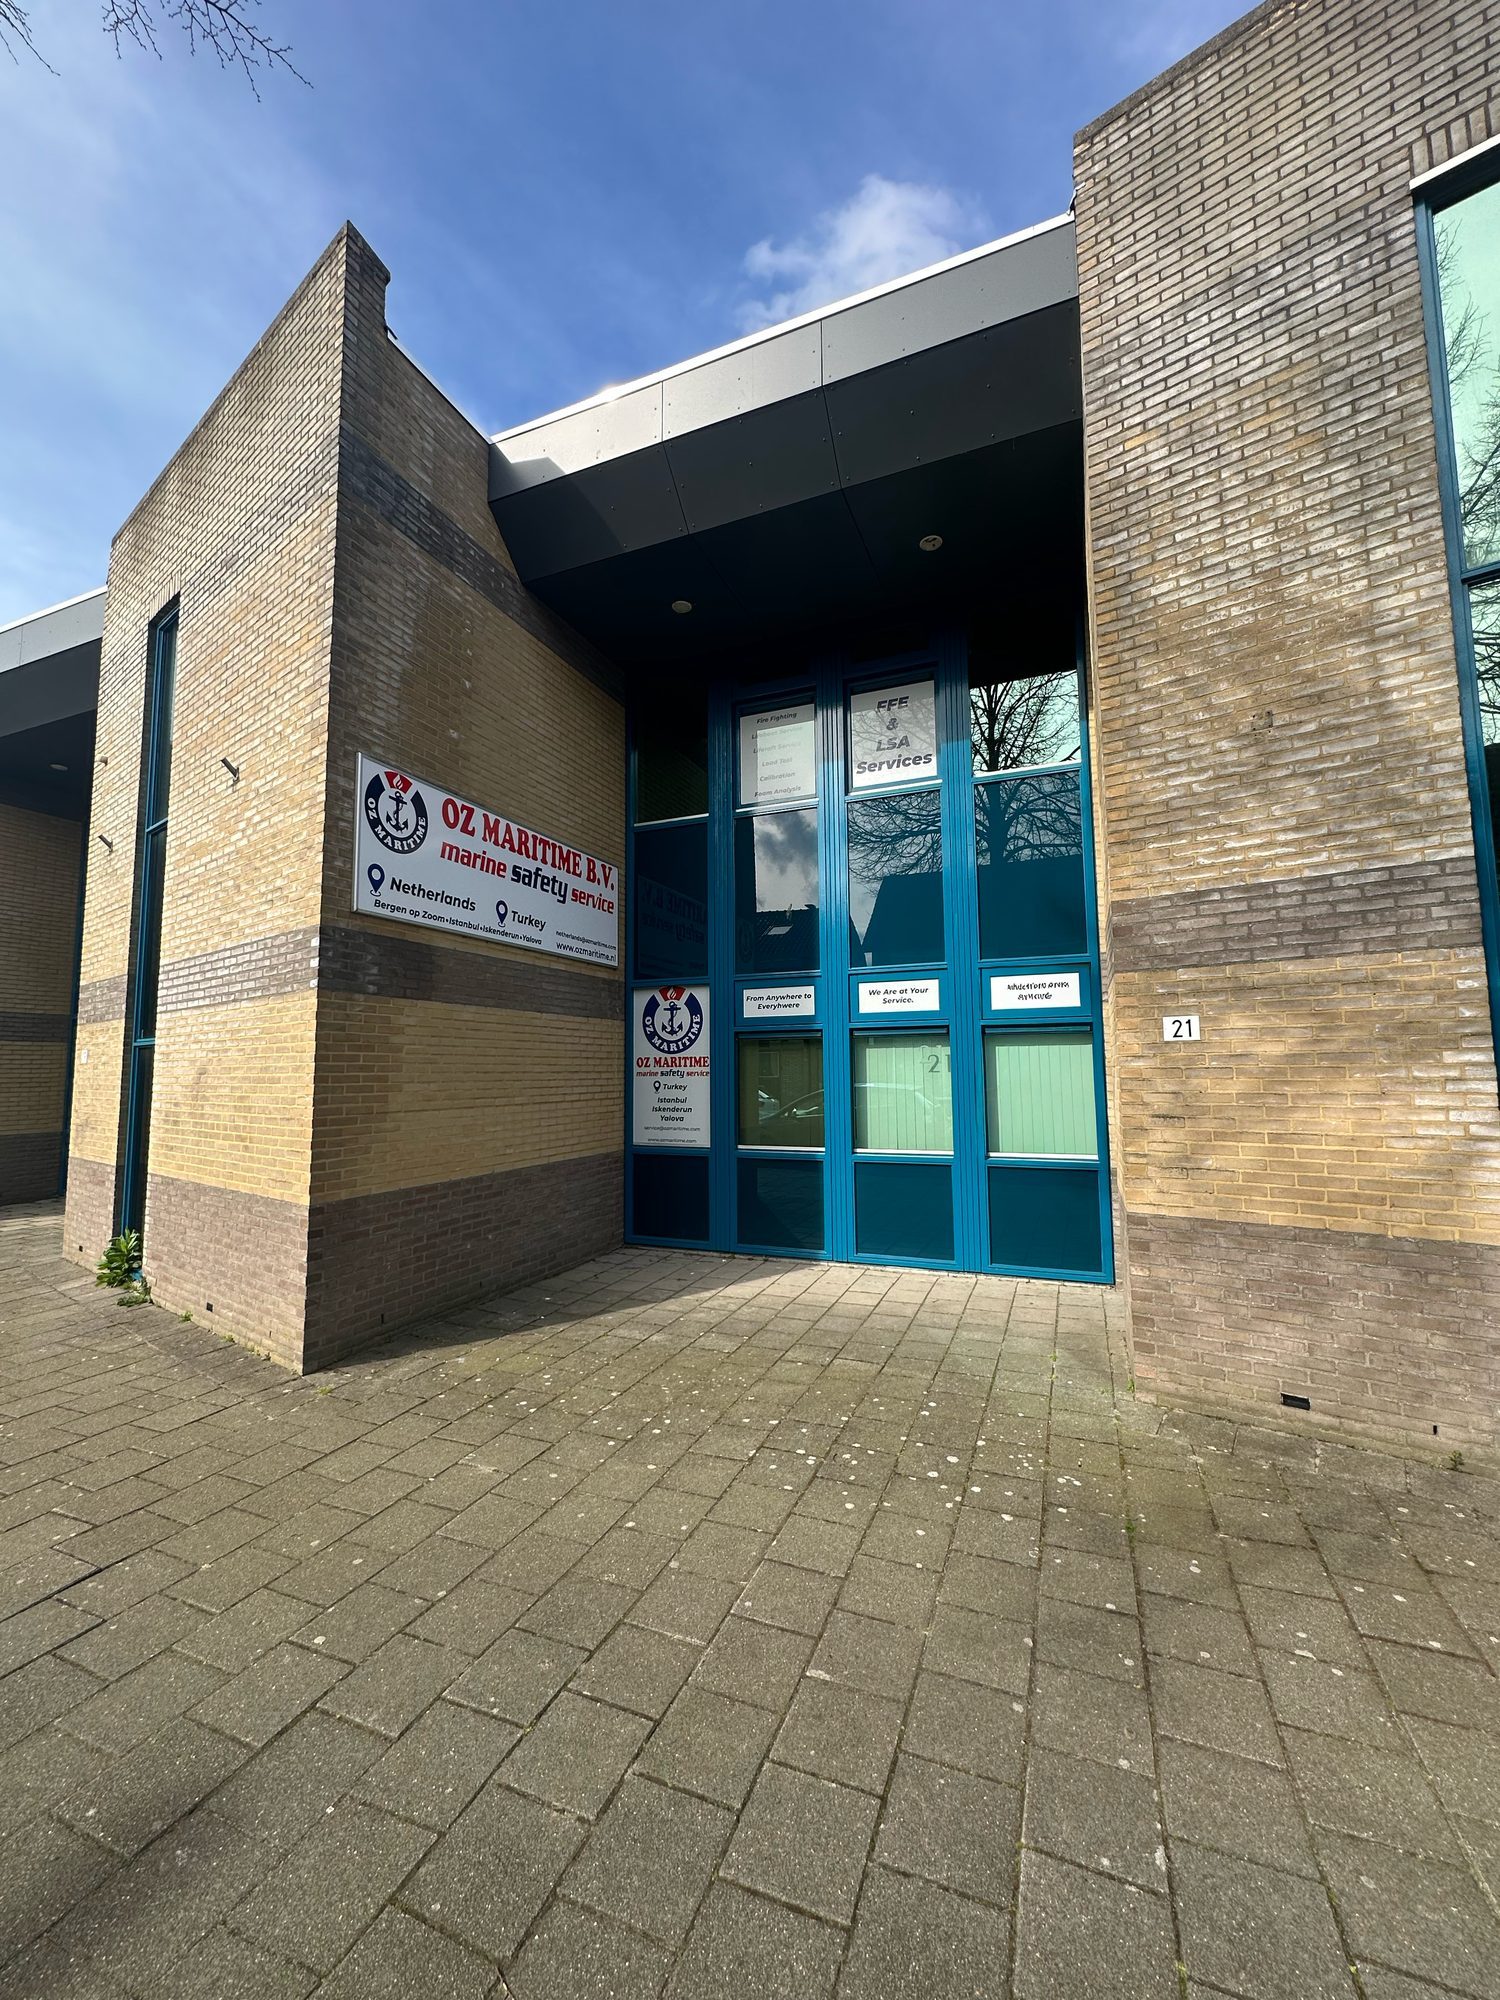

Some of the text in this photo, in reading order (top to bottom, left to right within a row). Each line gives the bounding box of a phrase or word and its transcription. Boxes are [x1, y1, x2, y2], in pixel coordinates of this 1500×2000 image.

[770, 712, 797, 722] Fighting
[886, 717, 898, 731] &
[876, 734, 911, 752] LSA
[856, 752, 932, 774] Services
[773, 785, 801, 796] Analysis
[374, 816, 426, 851] MARITIME
[441, 797, 615, 891] OZ MARITIME B.V.
[440, 841, 614, 914] marine safety service
[390, 877, 477, 912] Netherlands
[374, 899, 407, 916] Bergen
[409, 908, 420, 919] op
[511, 910, 547, 931] Turkey
[556, 941, 617, 963] www.ozmaritime.nl
[766, 993, 802, 1003] Anywhere
[652, 1013, 701, 1051] MARITIME
[1172, 1019, 1192, 1038] 21
[636, 1056, 710, 1068] OZ MARITIME
[636, 1069, 710, 1079] marine safety service
[662, 1083, 688, 1092] Turkey
[652, 1105, 693, 1113] Iskenderun
[657, 1096, 687, 1104] Istanbul
[660, 1114, 685, 1122] Yalova
